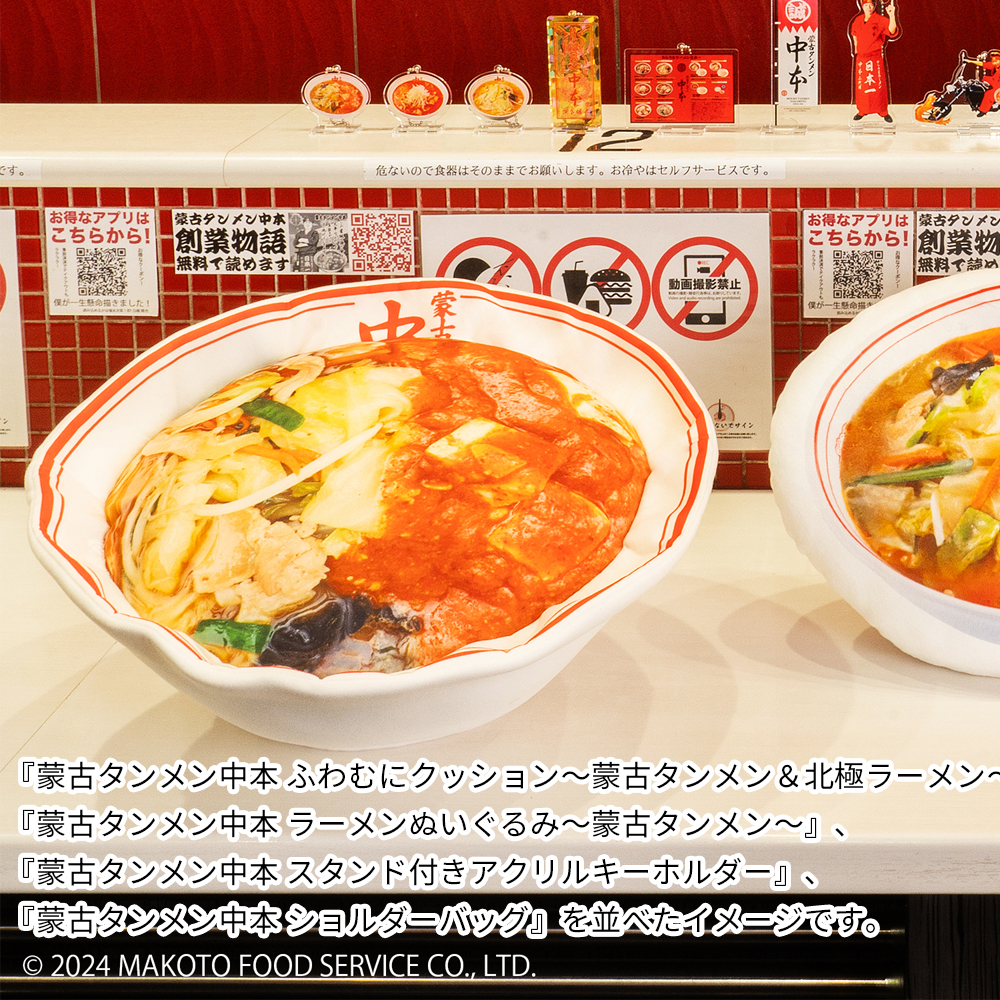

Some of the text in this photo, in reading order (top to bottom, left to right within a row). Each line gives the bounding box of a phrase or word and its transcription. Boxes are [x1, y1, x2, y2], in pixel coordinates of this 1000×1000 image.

[786, 35, 808, 95] 中本
[864, 60, 877, 93] 日本一
[568, 73, 582, 107] 中本
[559, 129, 654, 152] 12
[375, 164, 769, 178] 危ないので食器はそのままでお願いします。お冷やはセルフサービスです。
[50, 211, 150, 225] お得なアプリは
[175, 212, 287, 226] 蒙古タンメン中本
[807, 213, 909, 227] お得なアプリは
[51, 227, 150, 245] こちらから！
[175, 227, 287, 255] 創業物語
[808, 229, 909, 248] こちらから！
[177, 255, 290, 271] 無料で読めます
[668, 277, 742, 290] 動画撮影禁止
